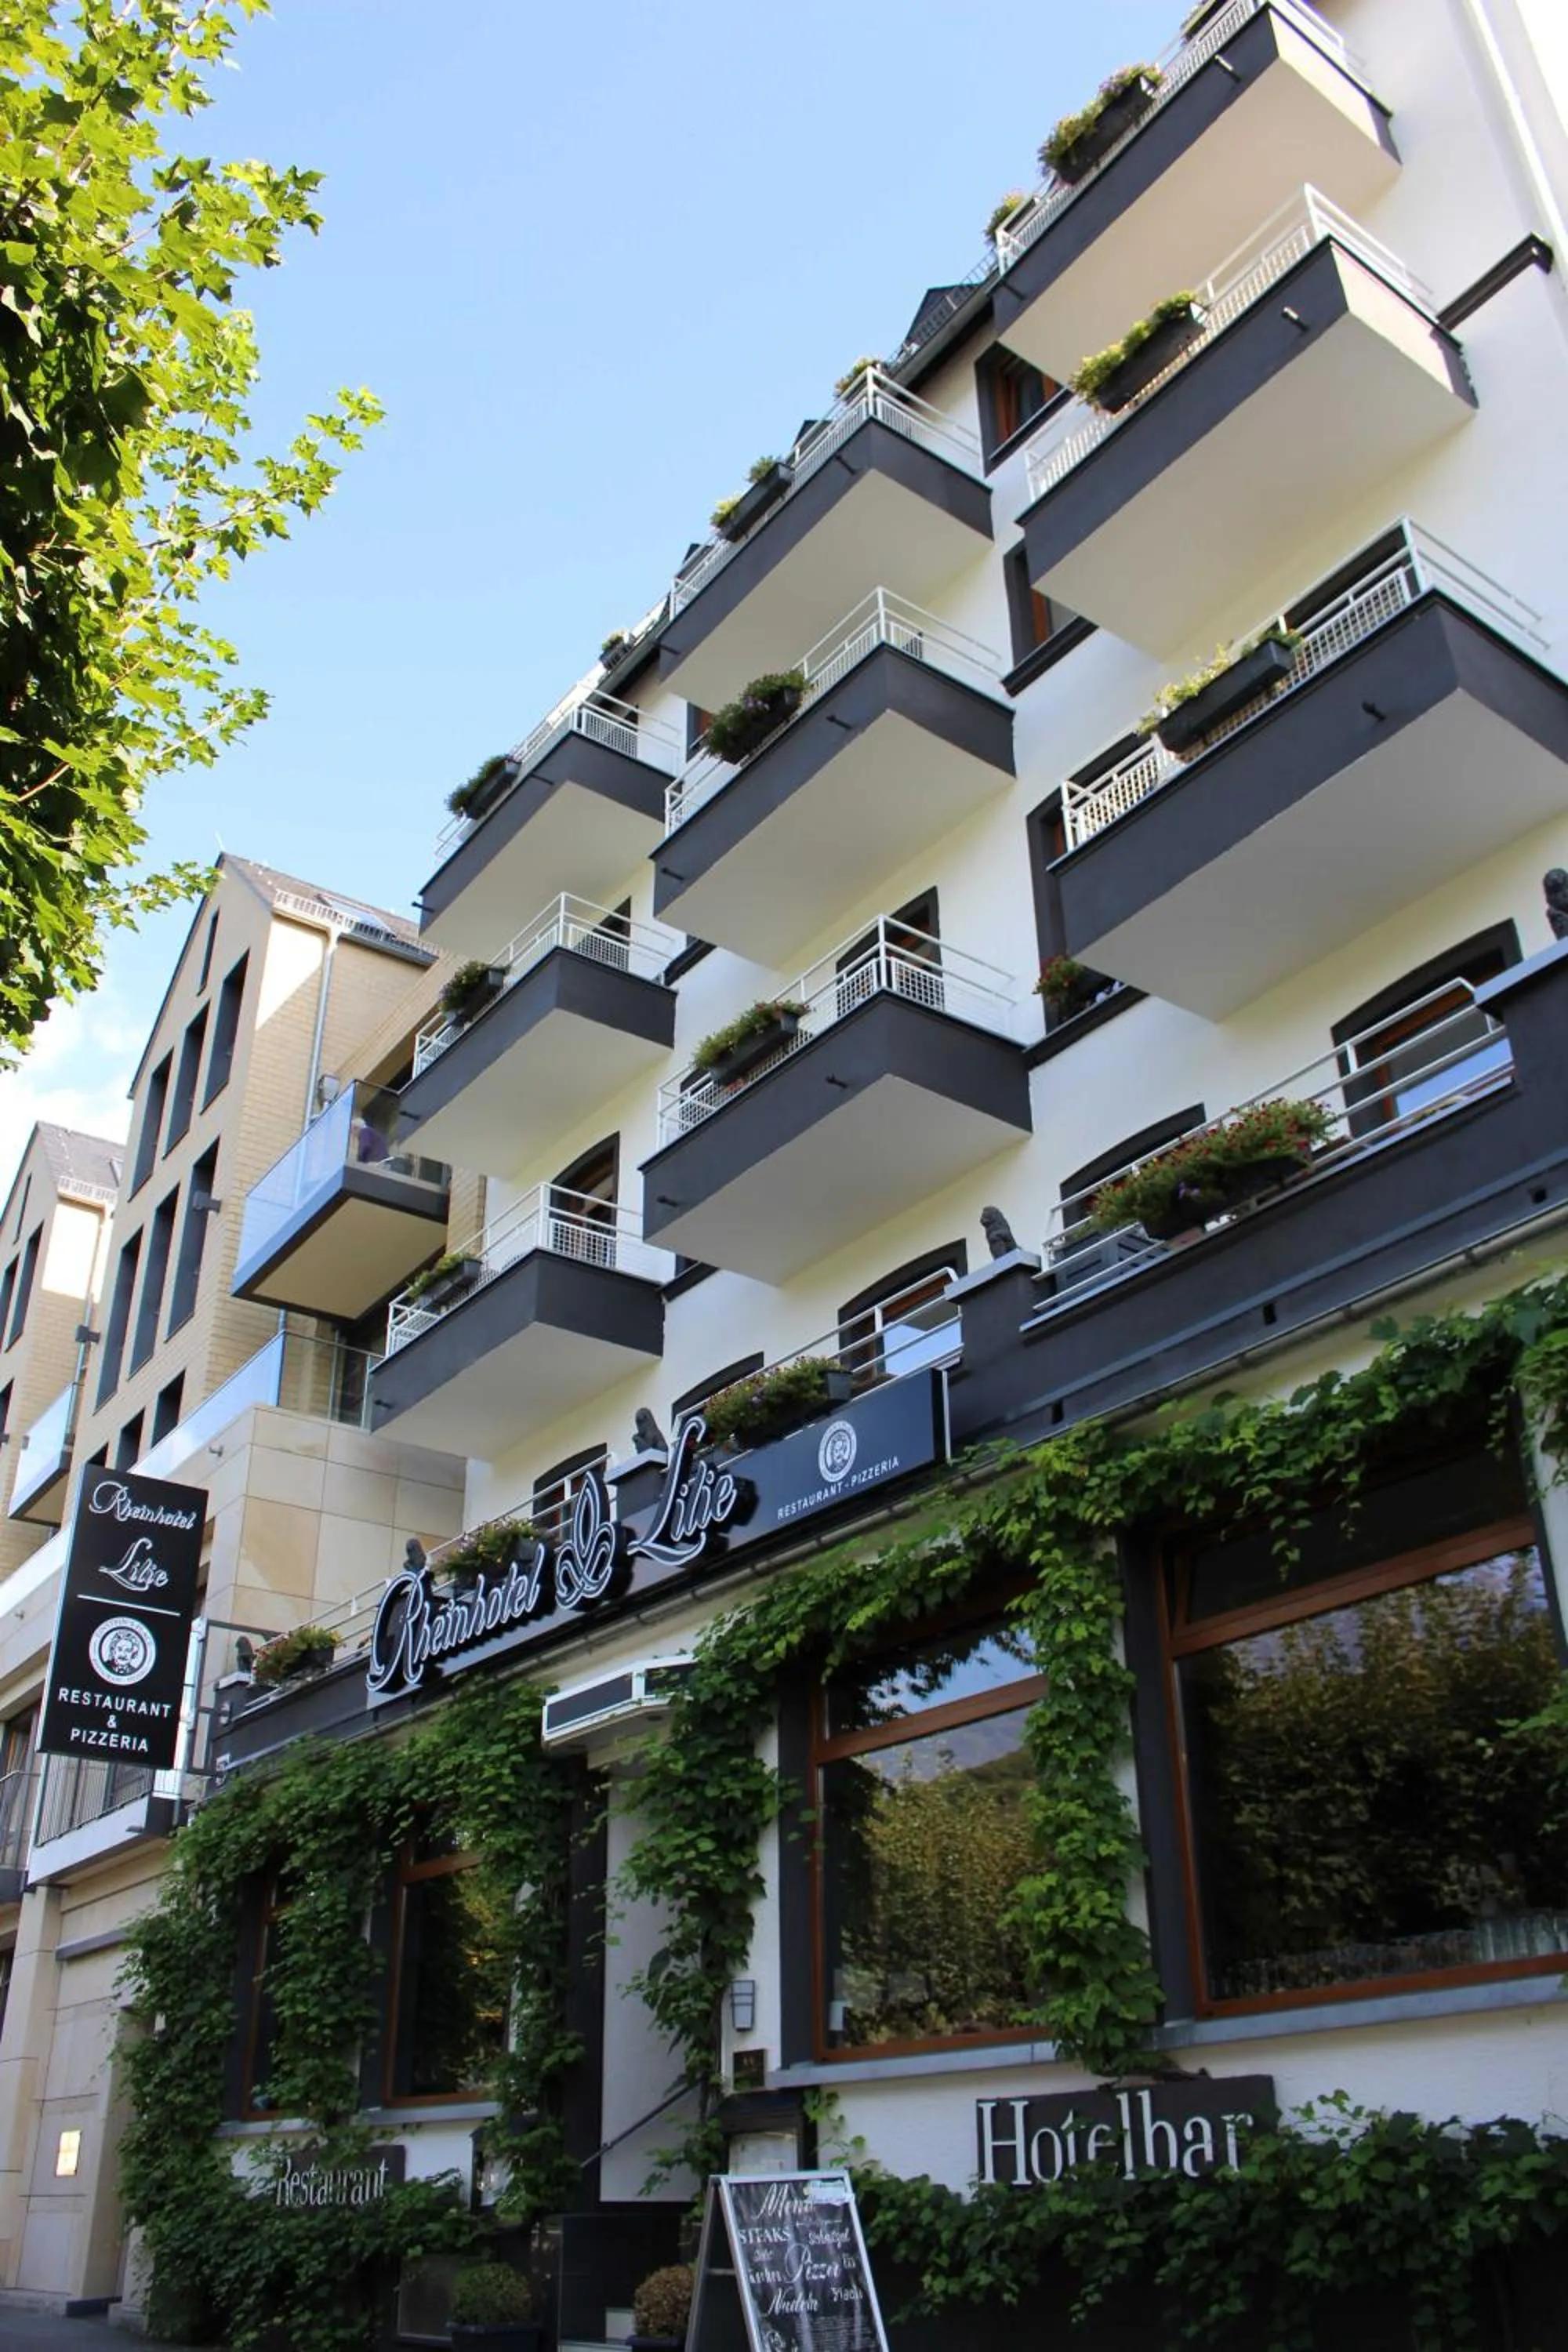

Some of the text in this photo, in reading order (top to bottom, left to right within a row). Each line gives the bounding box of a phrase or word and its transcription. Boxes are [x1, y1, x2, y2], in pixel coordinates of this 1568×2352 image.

[89, 1480, 197, 1530] Rheinhotel
[777, 1481, 843, 1520] RESTAURANT
[851, 1455, 900, 1488] PIZZERIA
[98, 1537, 169, 1592] Lilie
[366, 1542, 546, 1691] Rheinhotel
[626, 1416, 738, 1566] Lilie
[58, 1688, 172, 1719] RESTAURANT
[107, 1715, 118, 1729] &
[70, 1727, 149, 1753] PIZZERIA
